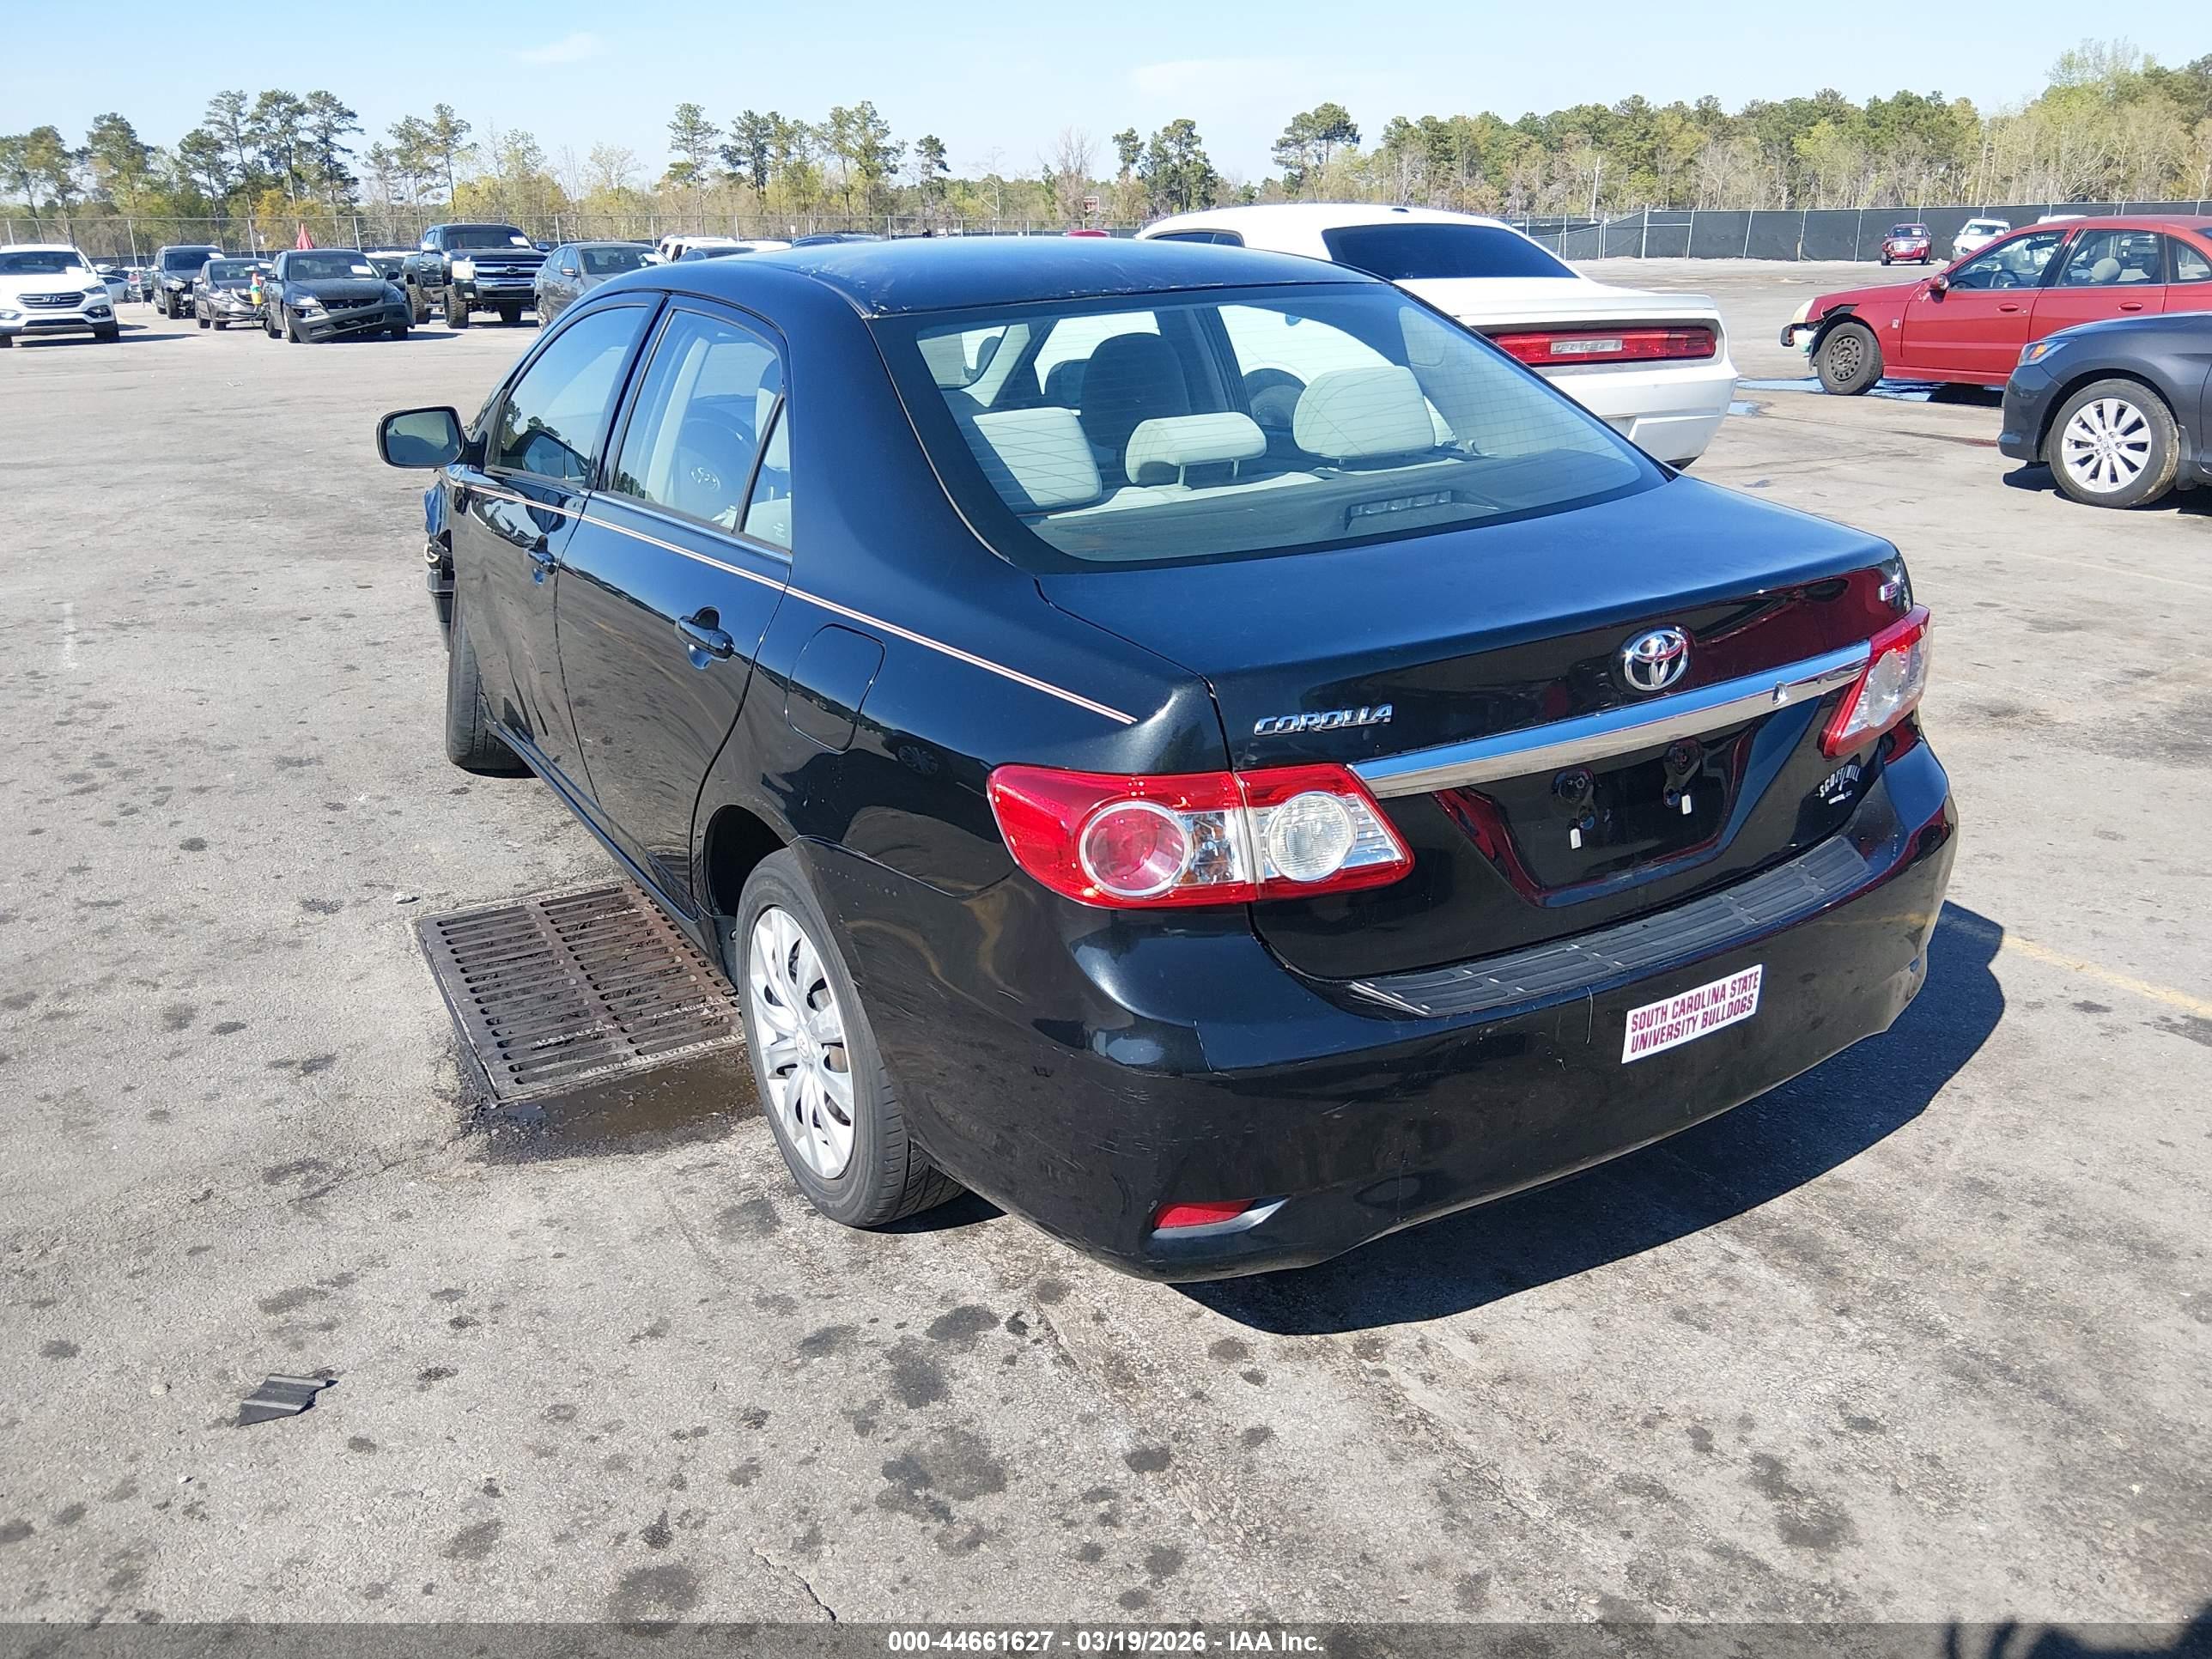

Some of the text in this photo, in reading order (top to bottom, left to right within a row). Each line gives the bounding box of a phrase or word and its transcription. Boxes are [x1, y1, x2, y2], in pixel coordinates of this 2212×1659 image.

[1254, 703, 1393, 736] COROLLA
[1631, 970, 1759, 1033] SOUTH CAROLINA STATE
[1631, 993, 1754, 1054] UNIVERSITY BULLDOGS
